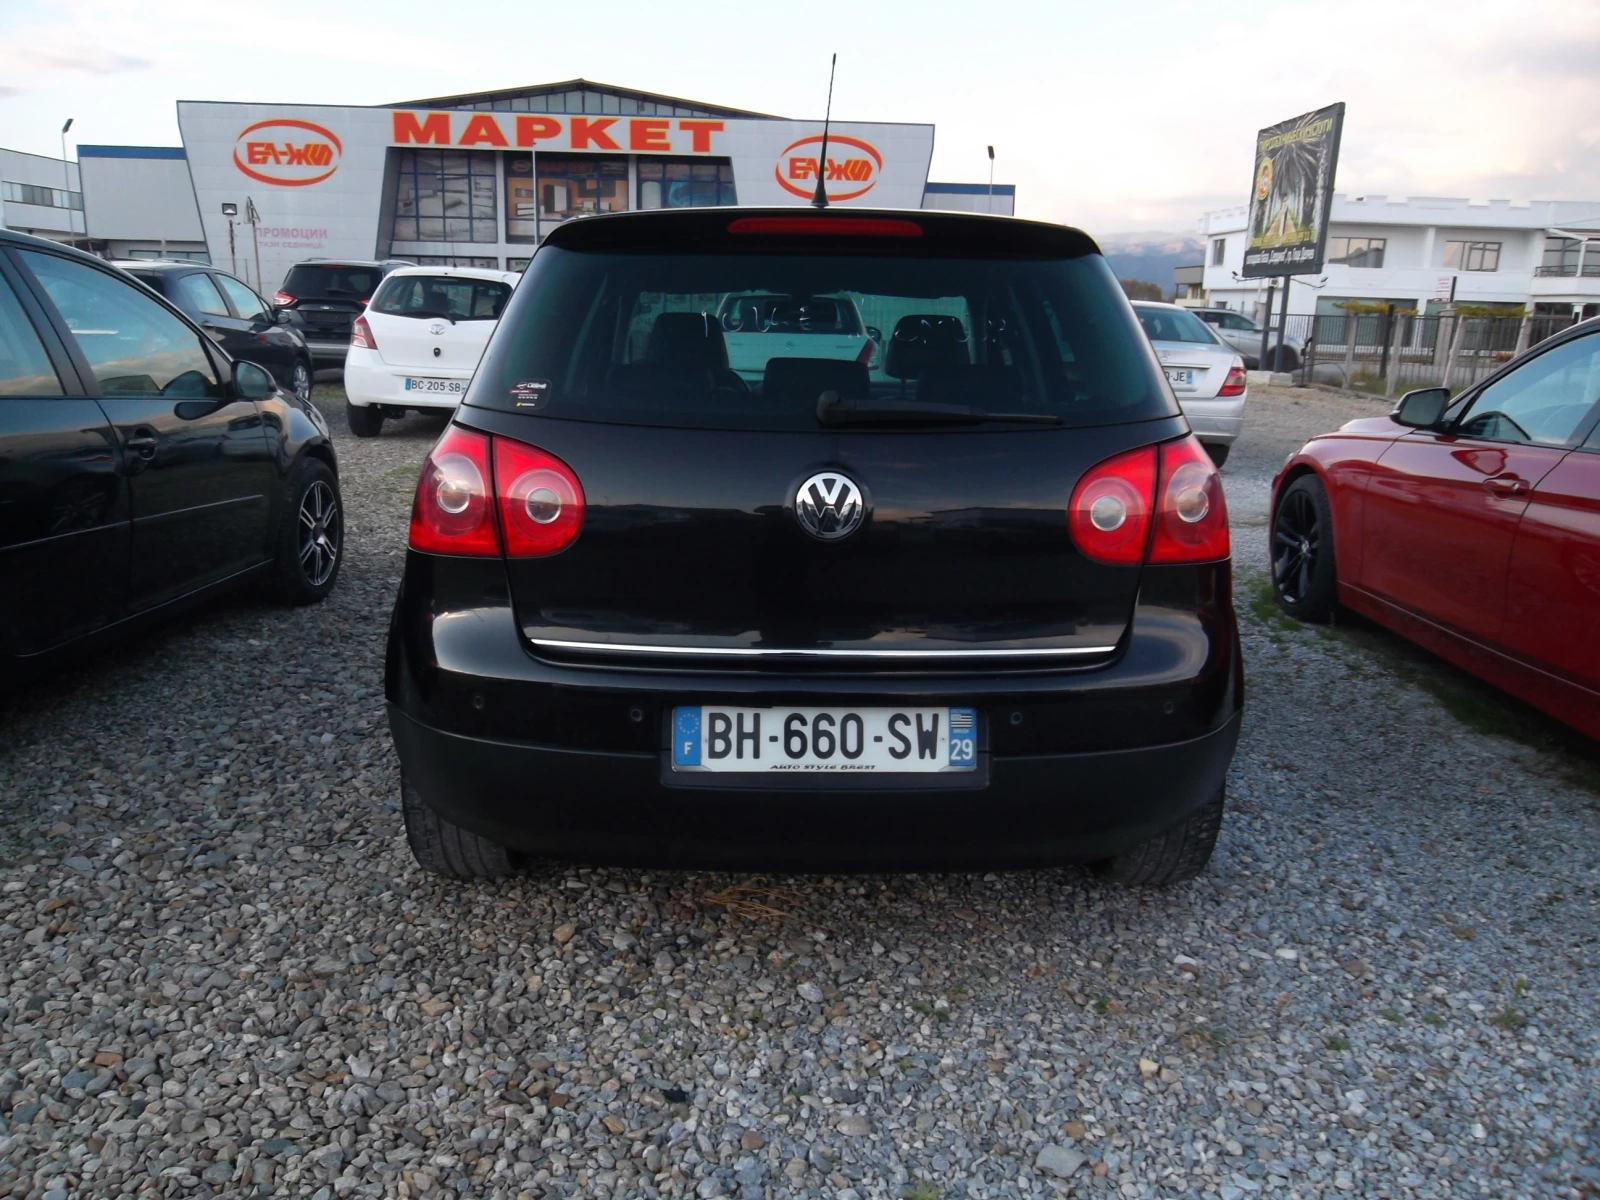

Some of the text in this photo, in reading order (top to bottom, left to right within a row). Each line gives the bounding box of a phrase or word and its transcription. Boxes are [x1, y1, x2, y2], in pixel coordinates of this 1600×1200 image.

[392, 111, 725, 153] МАРКЕТ
[255, 227, 329, 240] ПРОМОЦИИ
[410, 379, 461, 393] BC-205-SB
[707, 711, 941, 761] BH-660-SW
[684, 741, 693, 756] F
[950, 738, 973, 760] 29
